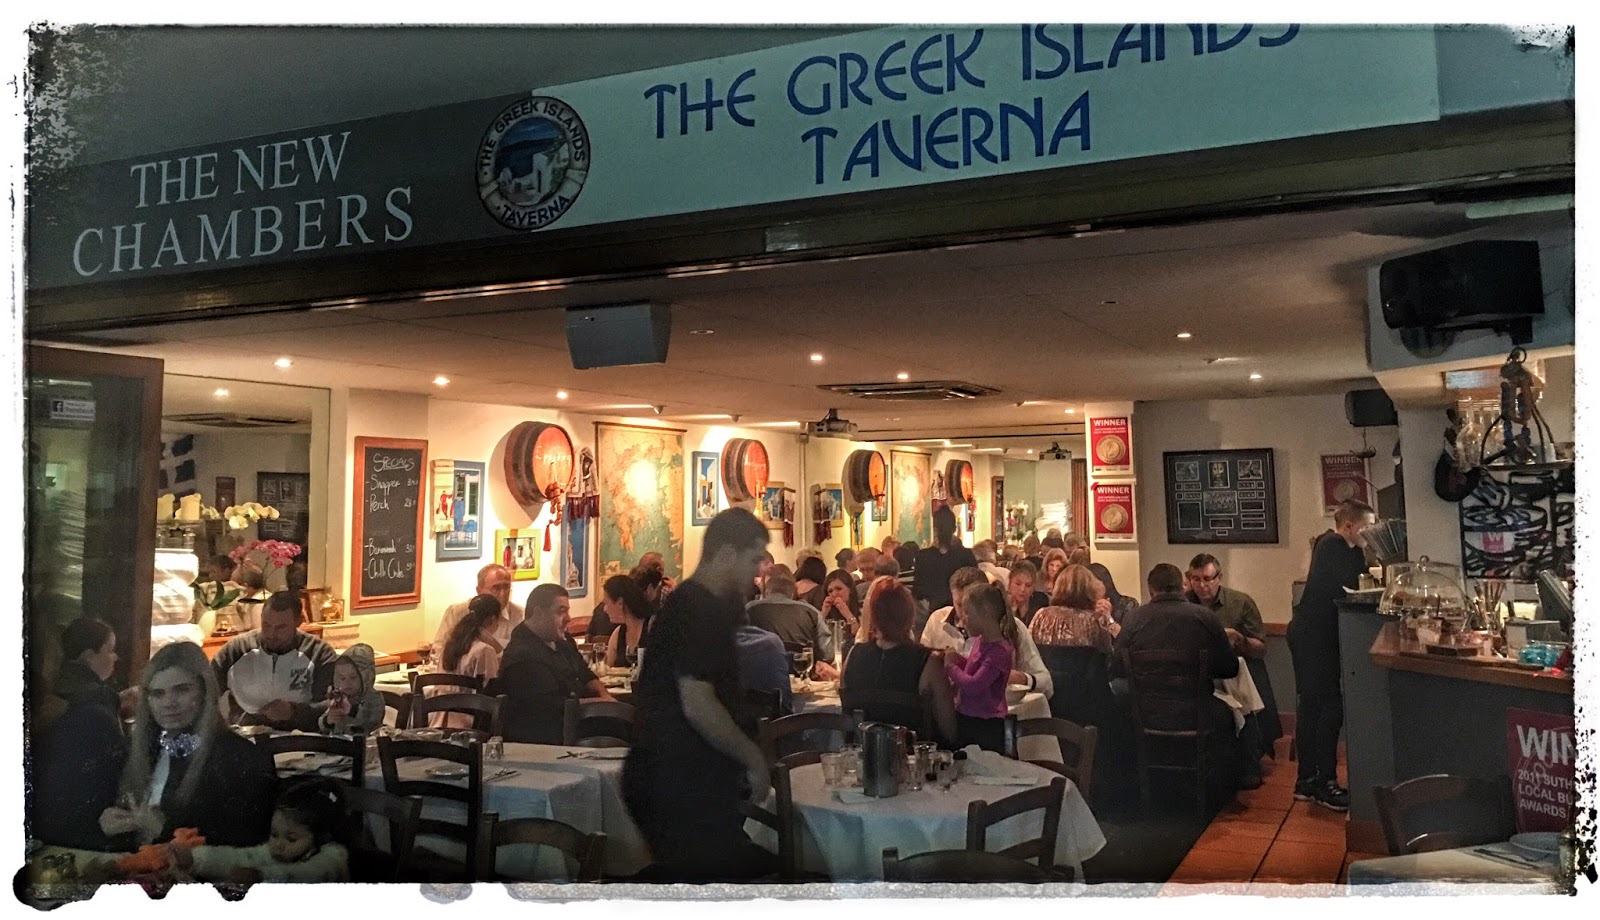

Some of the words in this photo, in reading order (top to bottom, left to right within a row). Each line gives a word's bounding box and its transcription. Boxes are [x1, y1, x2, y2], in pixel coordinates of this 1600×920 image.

[644, 68, 756, 139] THE
[787, 27, 985, 116] GREEK
[480, 138, 497, 169] THE
[494, 100, 540, 135] GREEK
[542, 100, 586, 163] ISLANDS
[801, 89, 1091, 185] TAVERNA
[130, 151, 219, 209] THE
[232, 130, 352, 196] NEW
[500, 195, 571, 226] TAVERNA
[72, 184, 414, 277] CHAMBERS
[1093, 418, 1126, 427] WINNER
[1325, 456, 1362, 464] WINNER
[1096, 486, 1130, 494] WINNER
[1518, 783, 1555, 802] LOCAL
[1520, 798, 1567, 819] AWARDS
